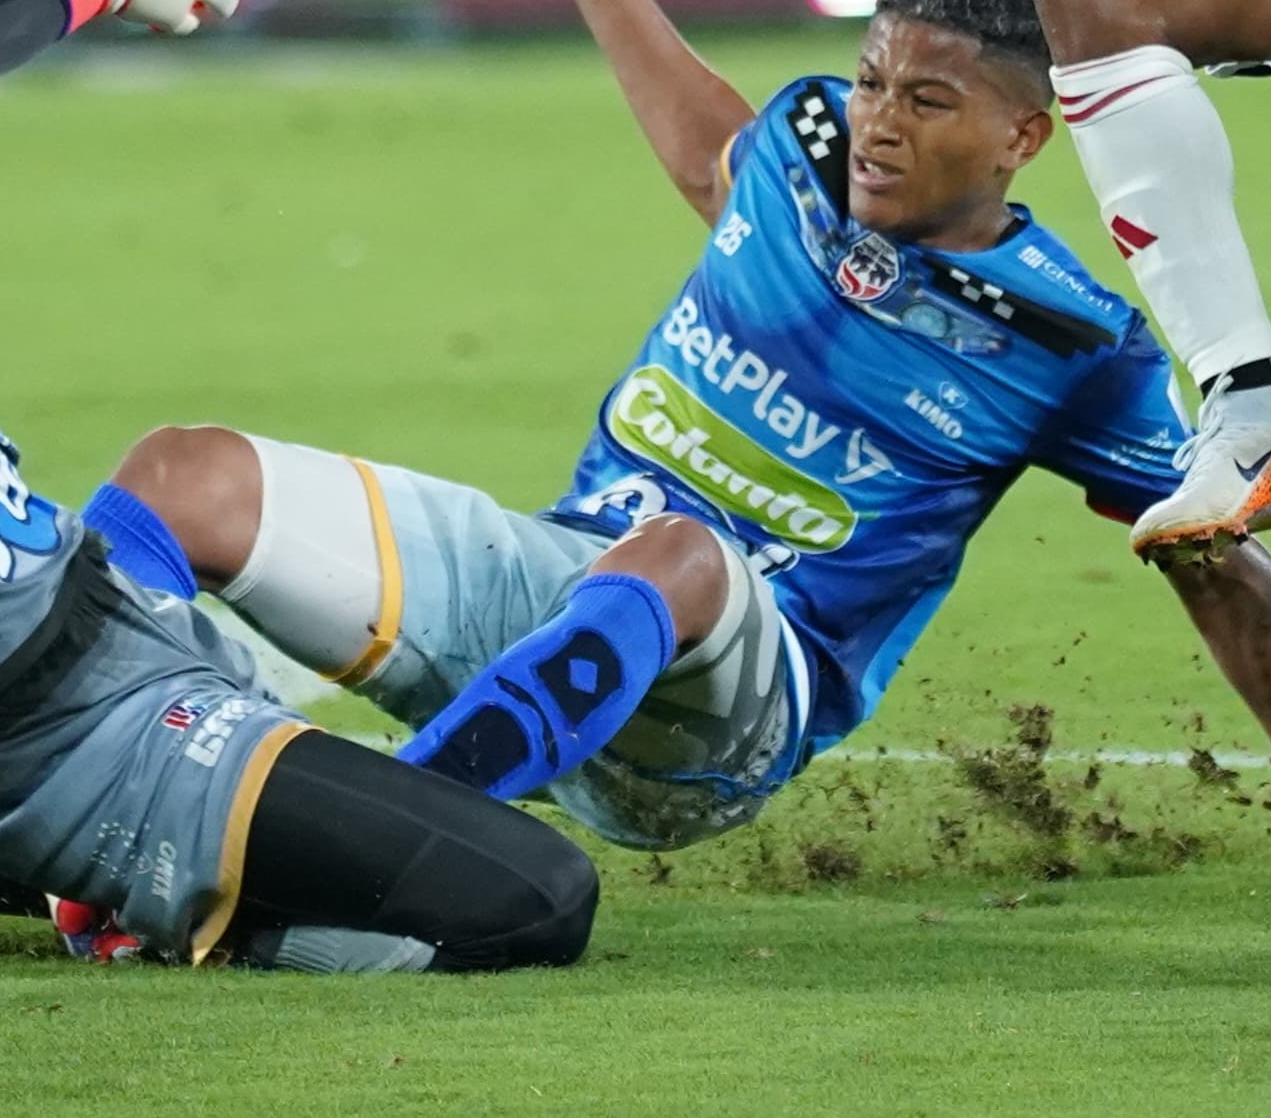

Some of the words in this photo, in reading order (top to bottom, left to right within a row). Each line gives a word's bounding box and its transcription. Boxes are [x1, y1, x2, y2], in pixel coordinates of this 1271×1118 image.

[662, 296, 841, 460] BetPlay
[904, 388, 964, 440] KIMO
[618, 378, 844, 545] Colanta
